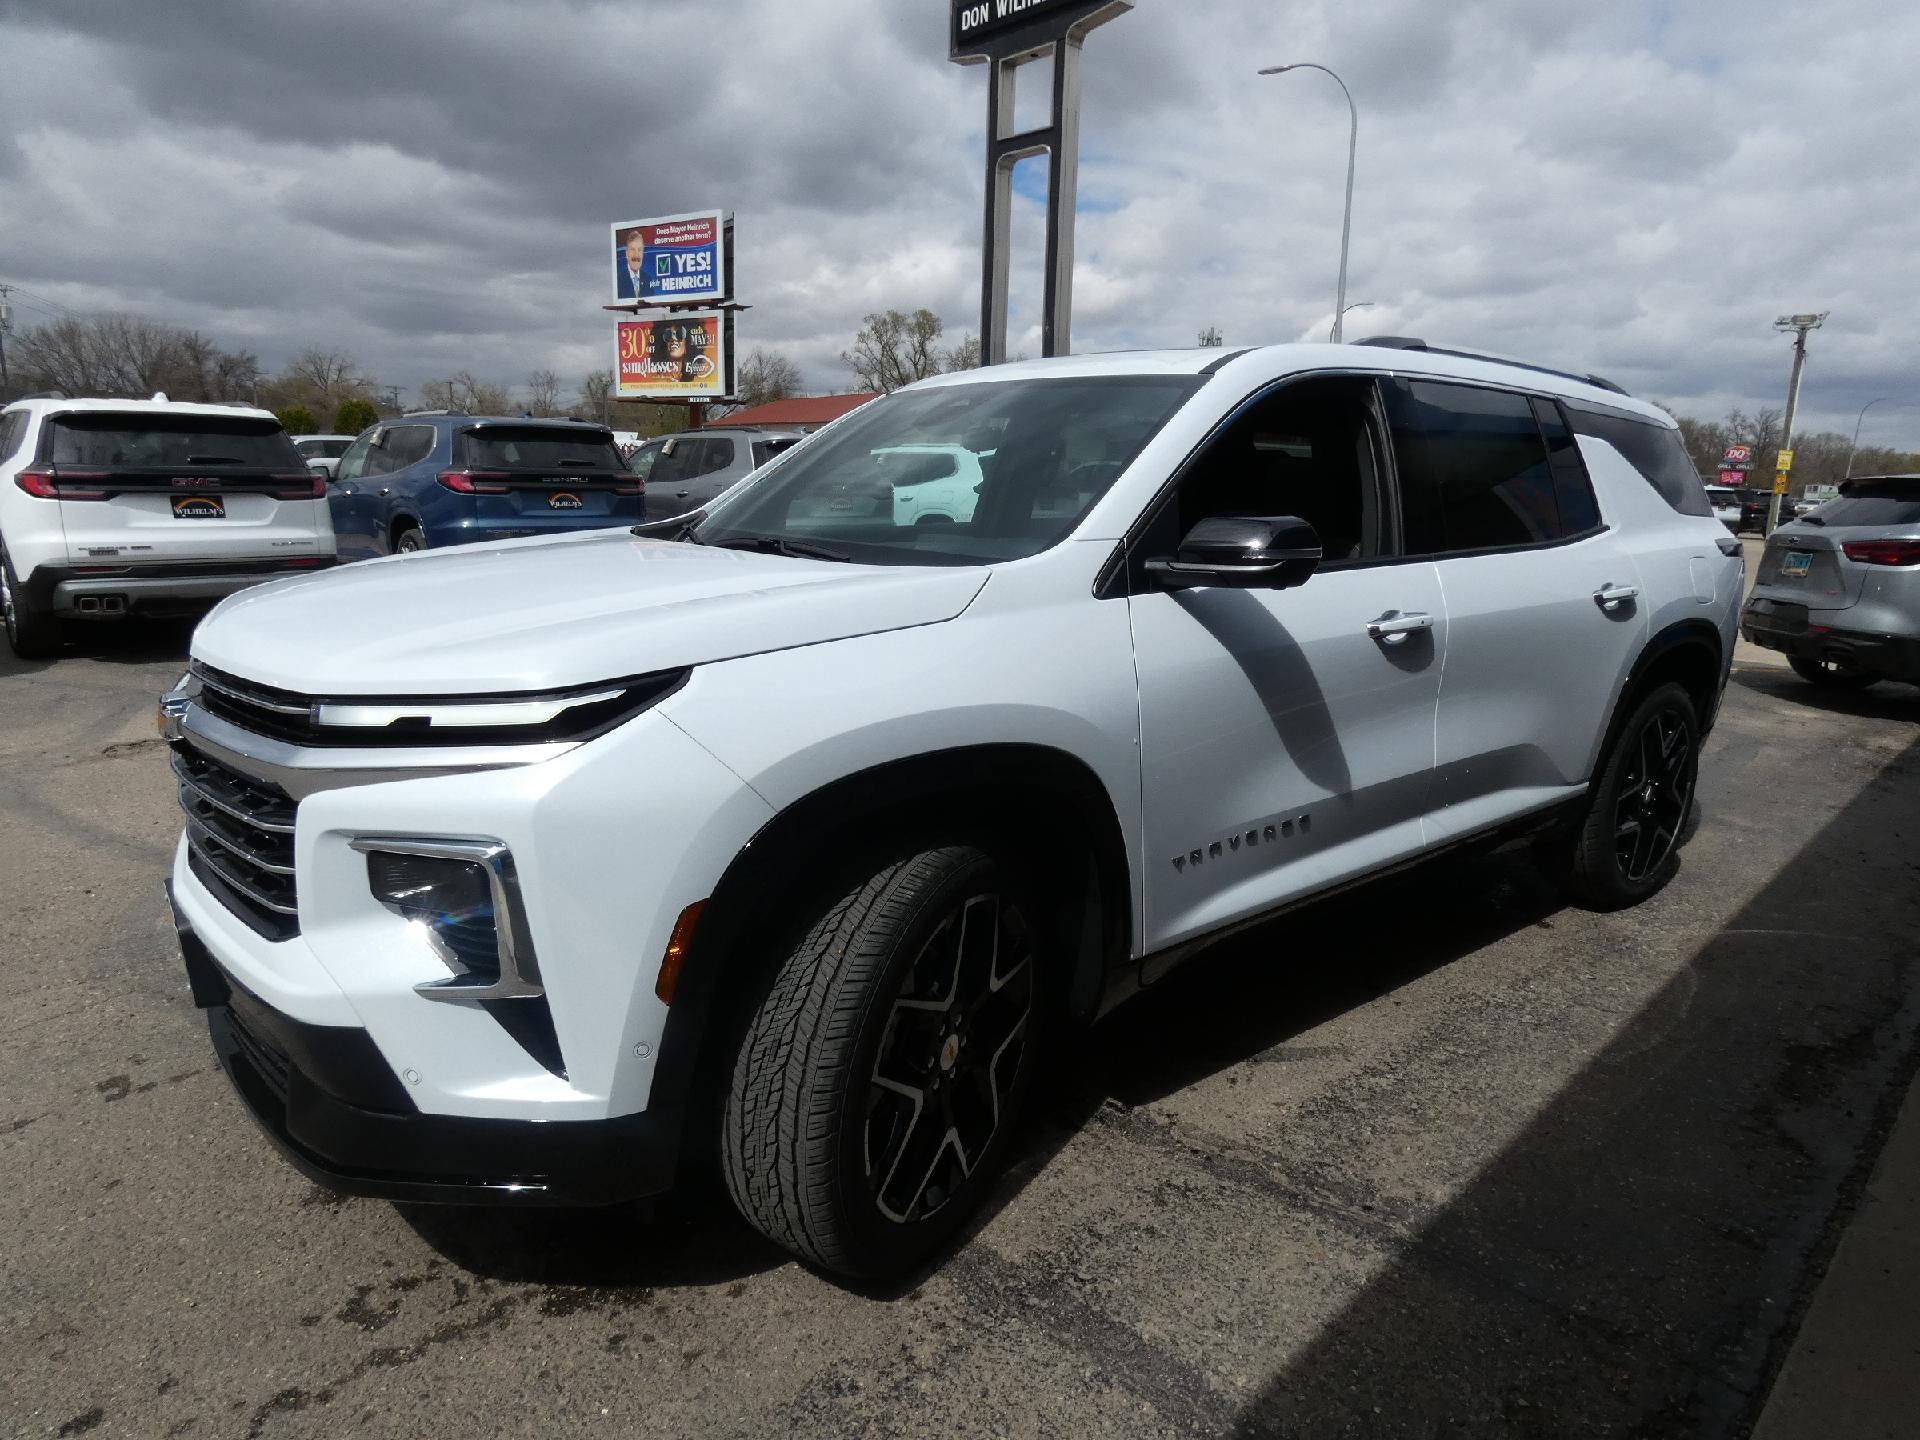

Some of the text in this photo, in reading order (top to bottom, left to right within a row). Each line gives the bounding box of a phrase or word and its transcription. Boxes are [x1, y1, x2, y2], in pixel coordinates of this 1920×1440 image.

[961, 2, 989, 31] DON
[656, 227, 670, 235] Does
[670, 224, 686, 234] Mayor
[674, 251, 711, 273] YES!
[661, 273, 712, 291] HEINRICH
[690, 334, 707, 346] MAY
[622, 357, 679, 378] sunglasses
[1728, 449, 1746, 459] DQ
[171, 477, 220, 487] GMC
[1169, 813, 1312, 873] TRAVERSE
